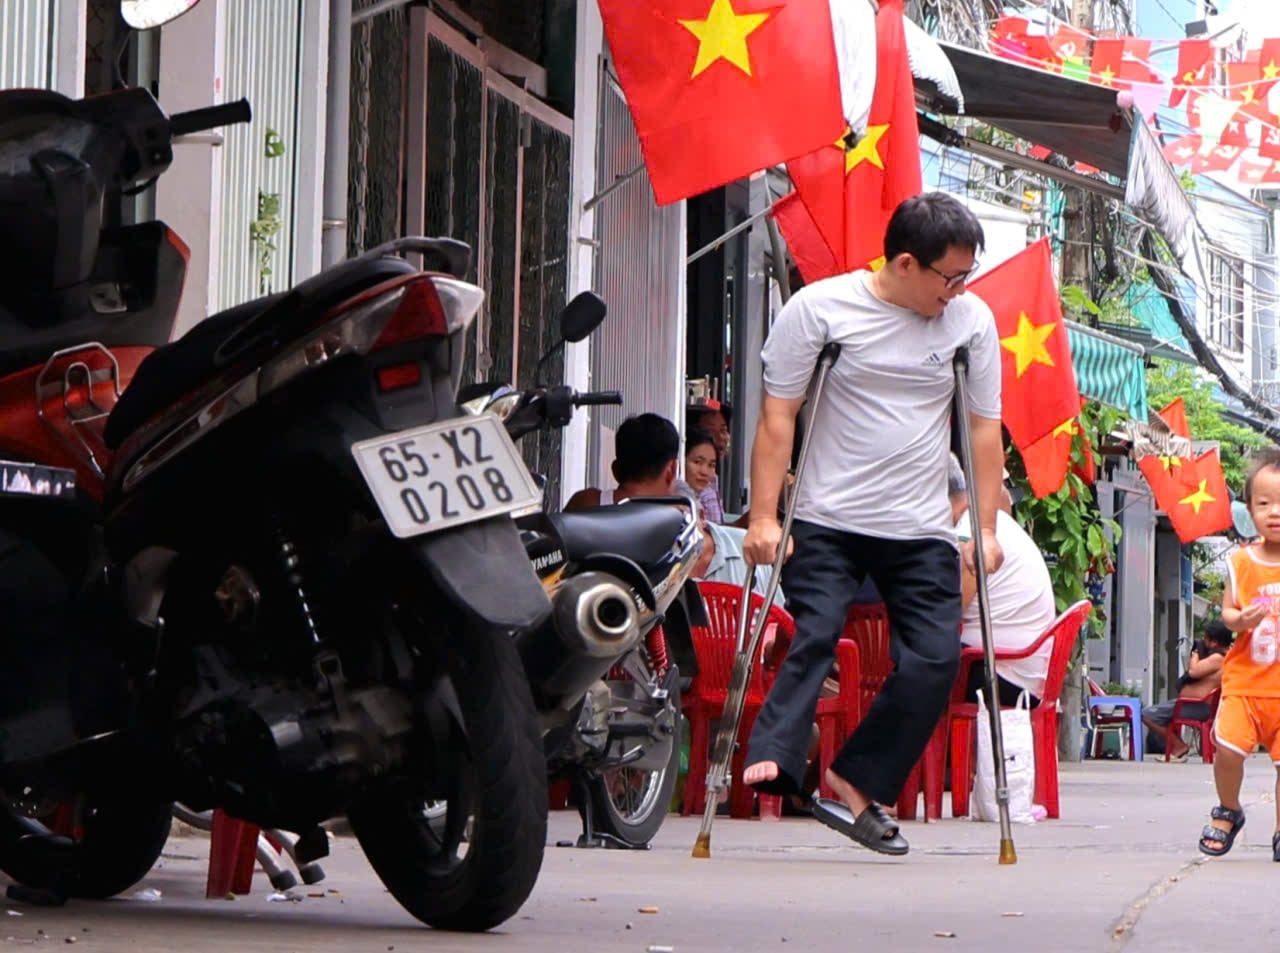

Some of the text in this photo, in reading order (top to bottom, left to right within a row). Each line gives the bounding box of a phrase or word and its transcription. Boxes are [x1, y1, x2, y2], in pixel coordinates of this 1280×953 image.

[379, 427, 494, 483] 65-X2
[400, 467, 513, 525] 0208
[530, 549, 563, 571] YAMAHA
